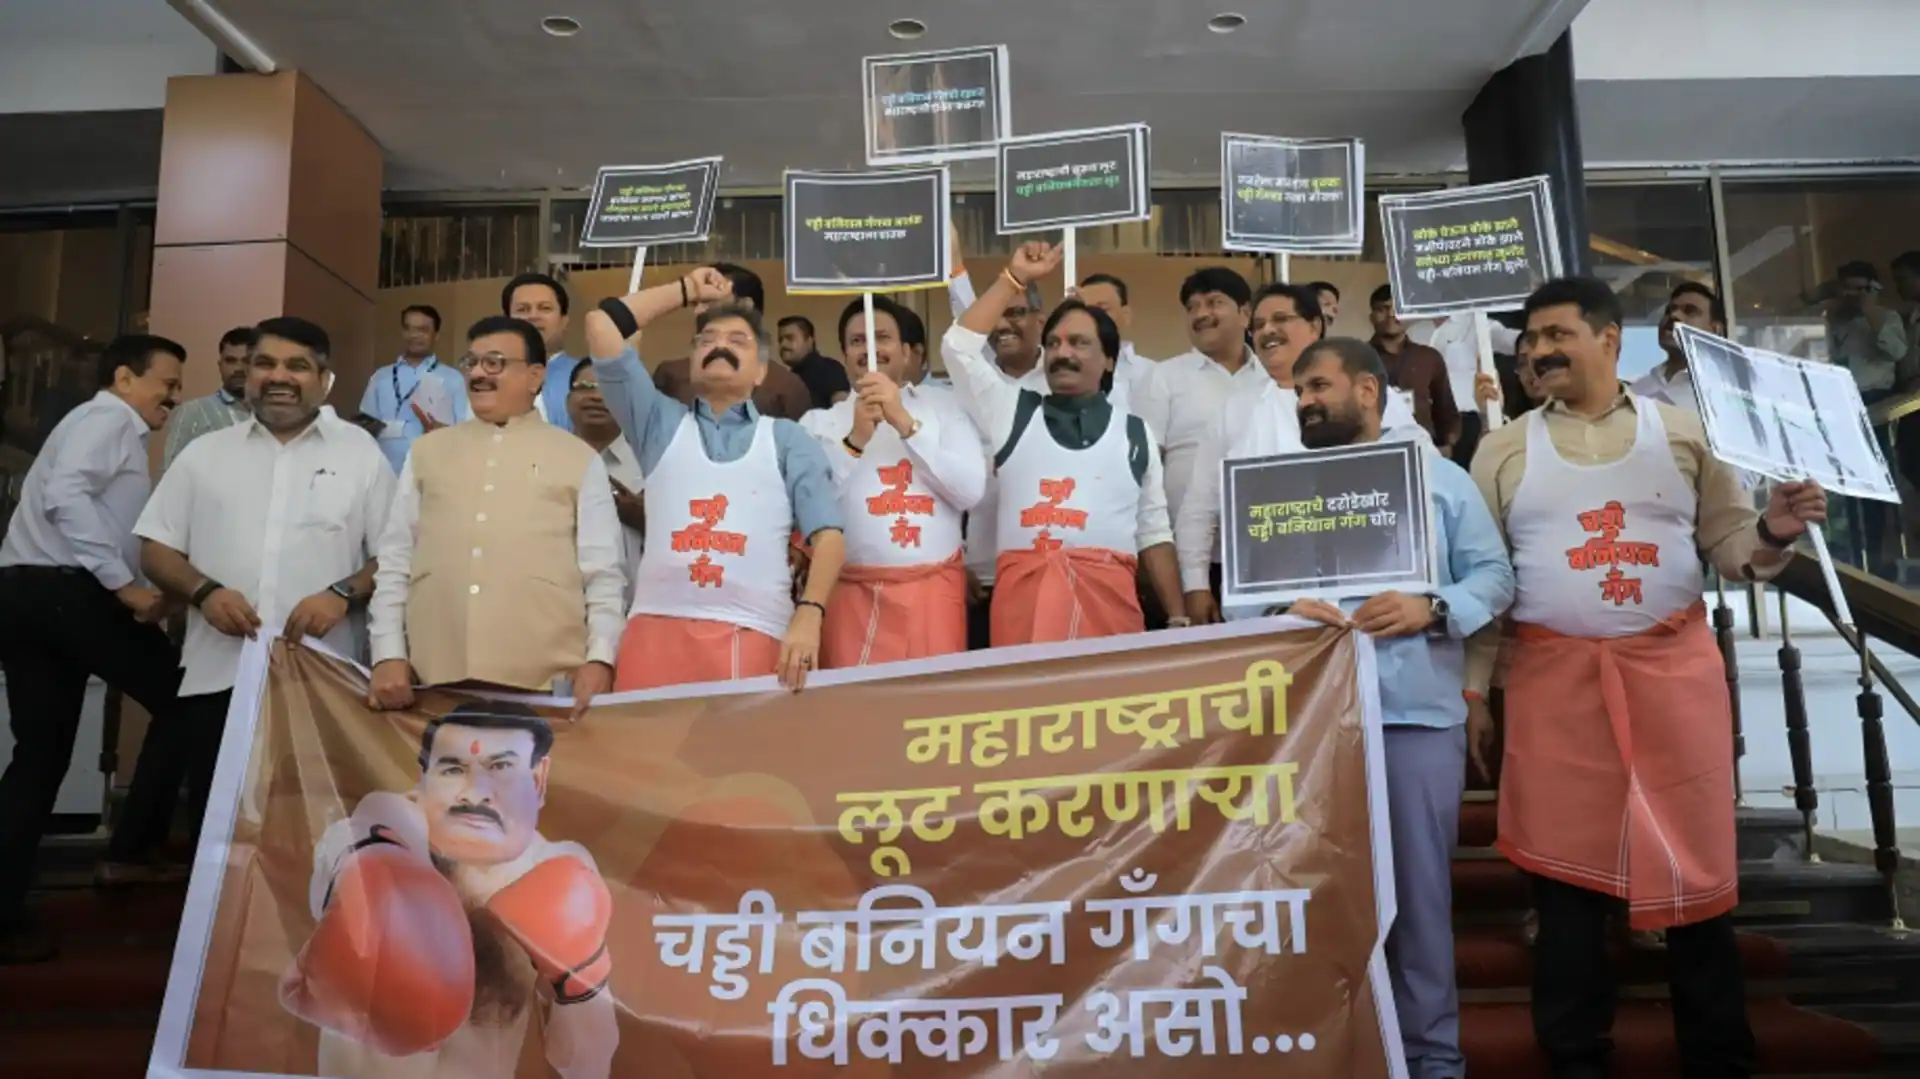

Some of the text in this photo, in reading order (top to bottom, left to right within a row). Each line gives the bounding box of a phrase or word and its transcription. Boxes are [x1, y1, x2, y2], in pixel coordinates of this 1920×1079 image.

[804, 217, 823, 232] चड्डी
[876, 458, 913, 495] चड्डी
[1040, 477, 1075, 506] चड्डी
[689, 493, 729, 529] चड्डी
[1247, 490, 1389, 519] महाराष्ट्राचे दरोडेखोर
[1577, 500, 1626, 541] चड्डी
[1245, 518, 1274, 542] चड्डी
[1339, 510, 1367, 529] गँग
[1368, 508, 1397, 526] चोर
[1598, 567, 1643, 605] गँग
[904, 660, 1294, 768] महाराष्ट्राची
[836, 762, 1300, 877] लूट करणाऱ्या
[652, 866, 1311, 1000] चड्डी बनियन गँगचा
[767, 966, 1317, 1067] धिक्कार असो...
